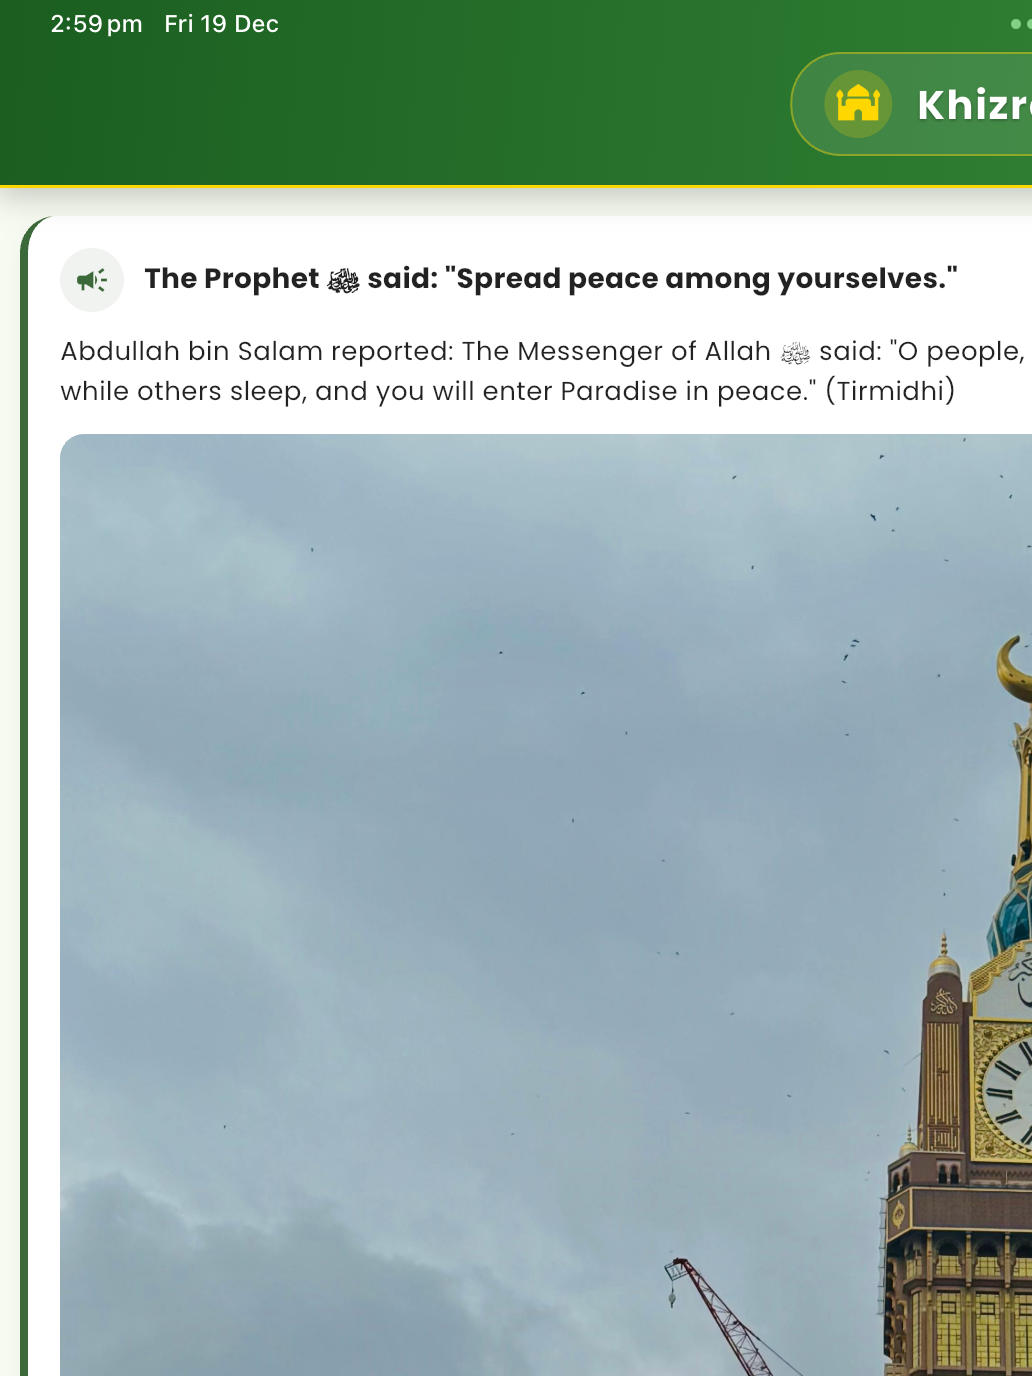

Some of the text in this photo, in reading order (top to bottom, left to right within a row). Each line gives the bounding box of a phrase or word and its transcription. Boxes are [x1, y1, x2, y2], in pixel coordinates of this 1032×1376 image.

[165, 13, 279, 33] Fri 19 Dec
[144, 266, 198, 289] The
[205, 266, 320, 297] Prophet
[367, 265, 438, 289] said:
[445, 264, 561, 297] "Spread
[569, 271, 659, 297] peace
[665, 271, 770, 297] among
[777, 264, 958, 297] yourselves."
[60, 340, 179, 361] Abdullah
[189, 339, 229, 361] bin
[238, 340, 323, 361] Salam
[332, 340, 453, 368] reported:
[461, 340, 509, 361] The
[518, 341, 663, 368] Messenger
[671, 339, 697, 361] of
[704, 340, 770, 361] Allah
[819, 339, 882, 361] said:
[890, 338, 918, 361] "O
[927, 340, 1025, 368] people,
[60, 375, 955, 408] while others sleep, and you will enter Paradise in peace." (Tirmidhi)
